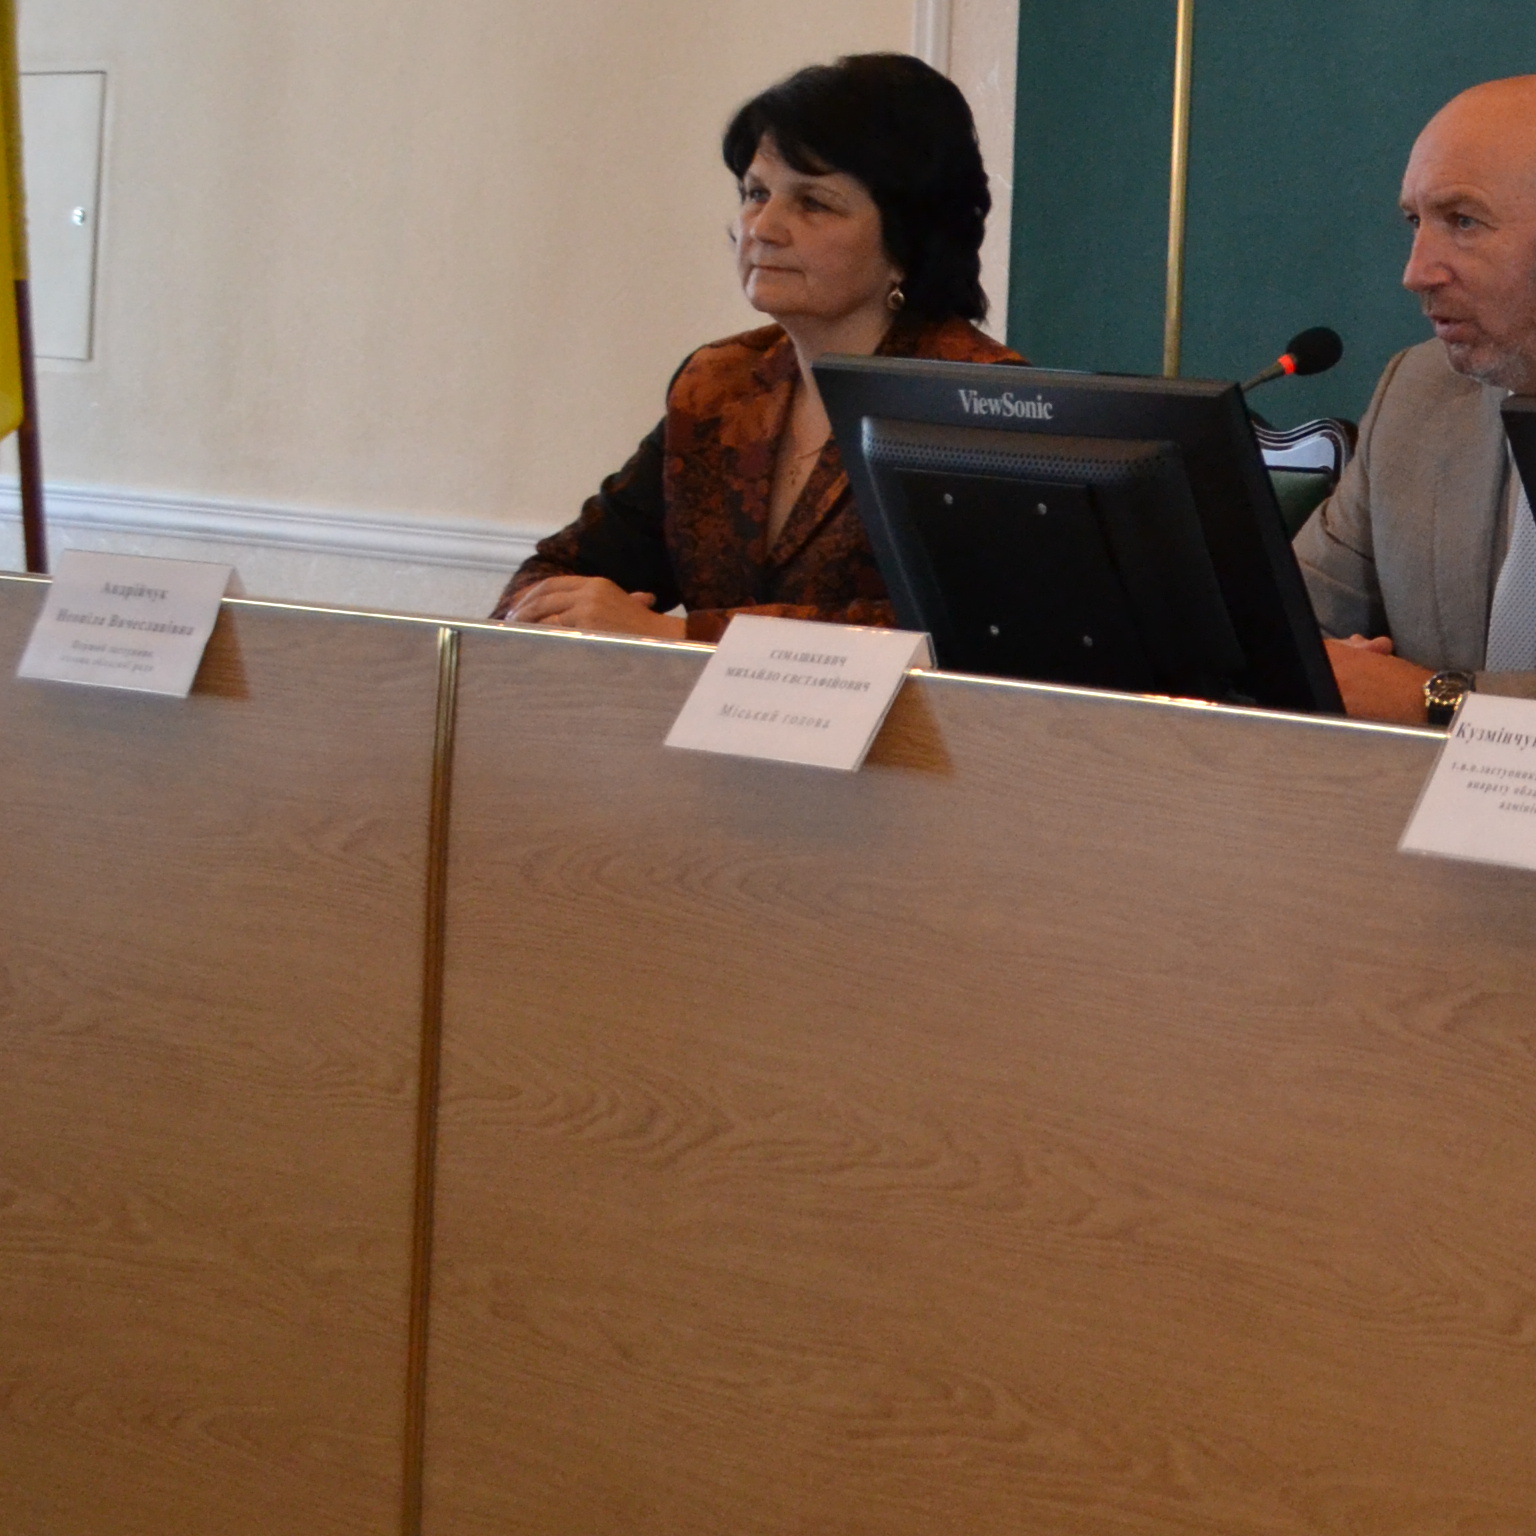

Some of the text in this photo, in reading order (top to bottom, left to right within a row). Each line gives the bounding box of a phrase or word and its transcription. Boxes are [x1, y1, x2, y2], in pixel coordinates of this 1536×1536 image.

[958, 388, 1053, 420] ViewSonic
[725, 665, 781, 682] МИХАЙЛО
[720, 702, 832, 730] Міський голова
